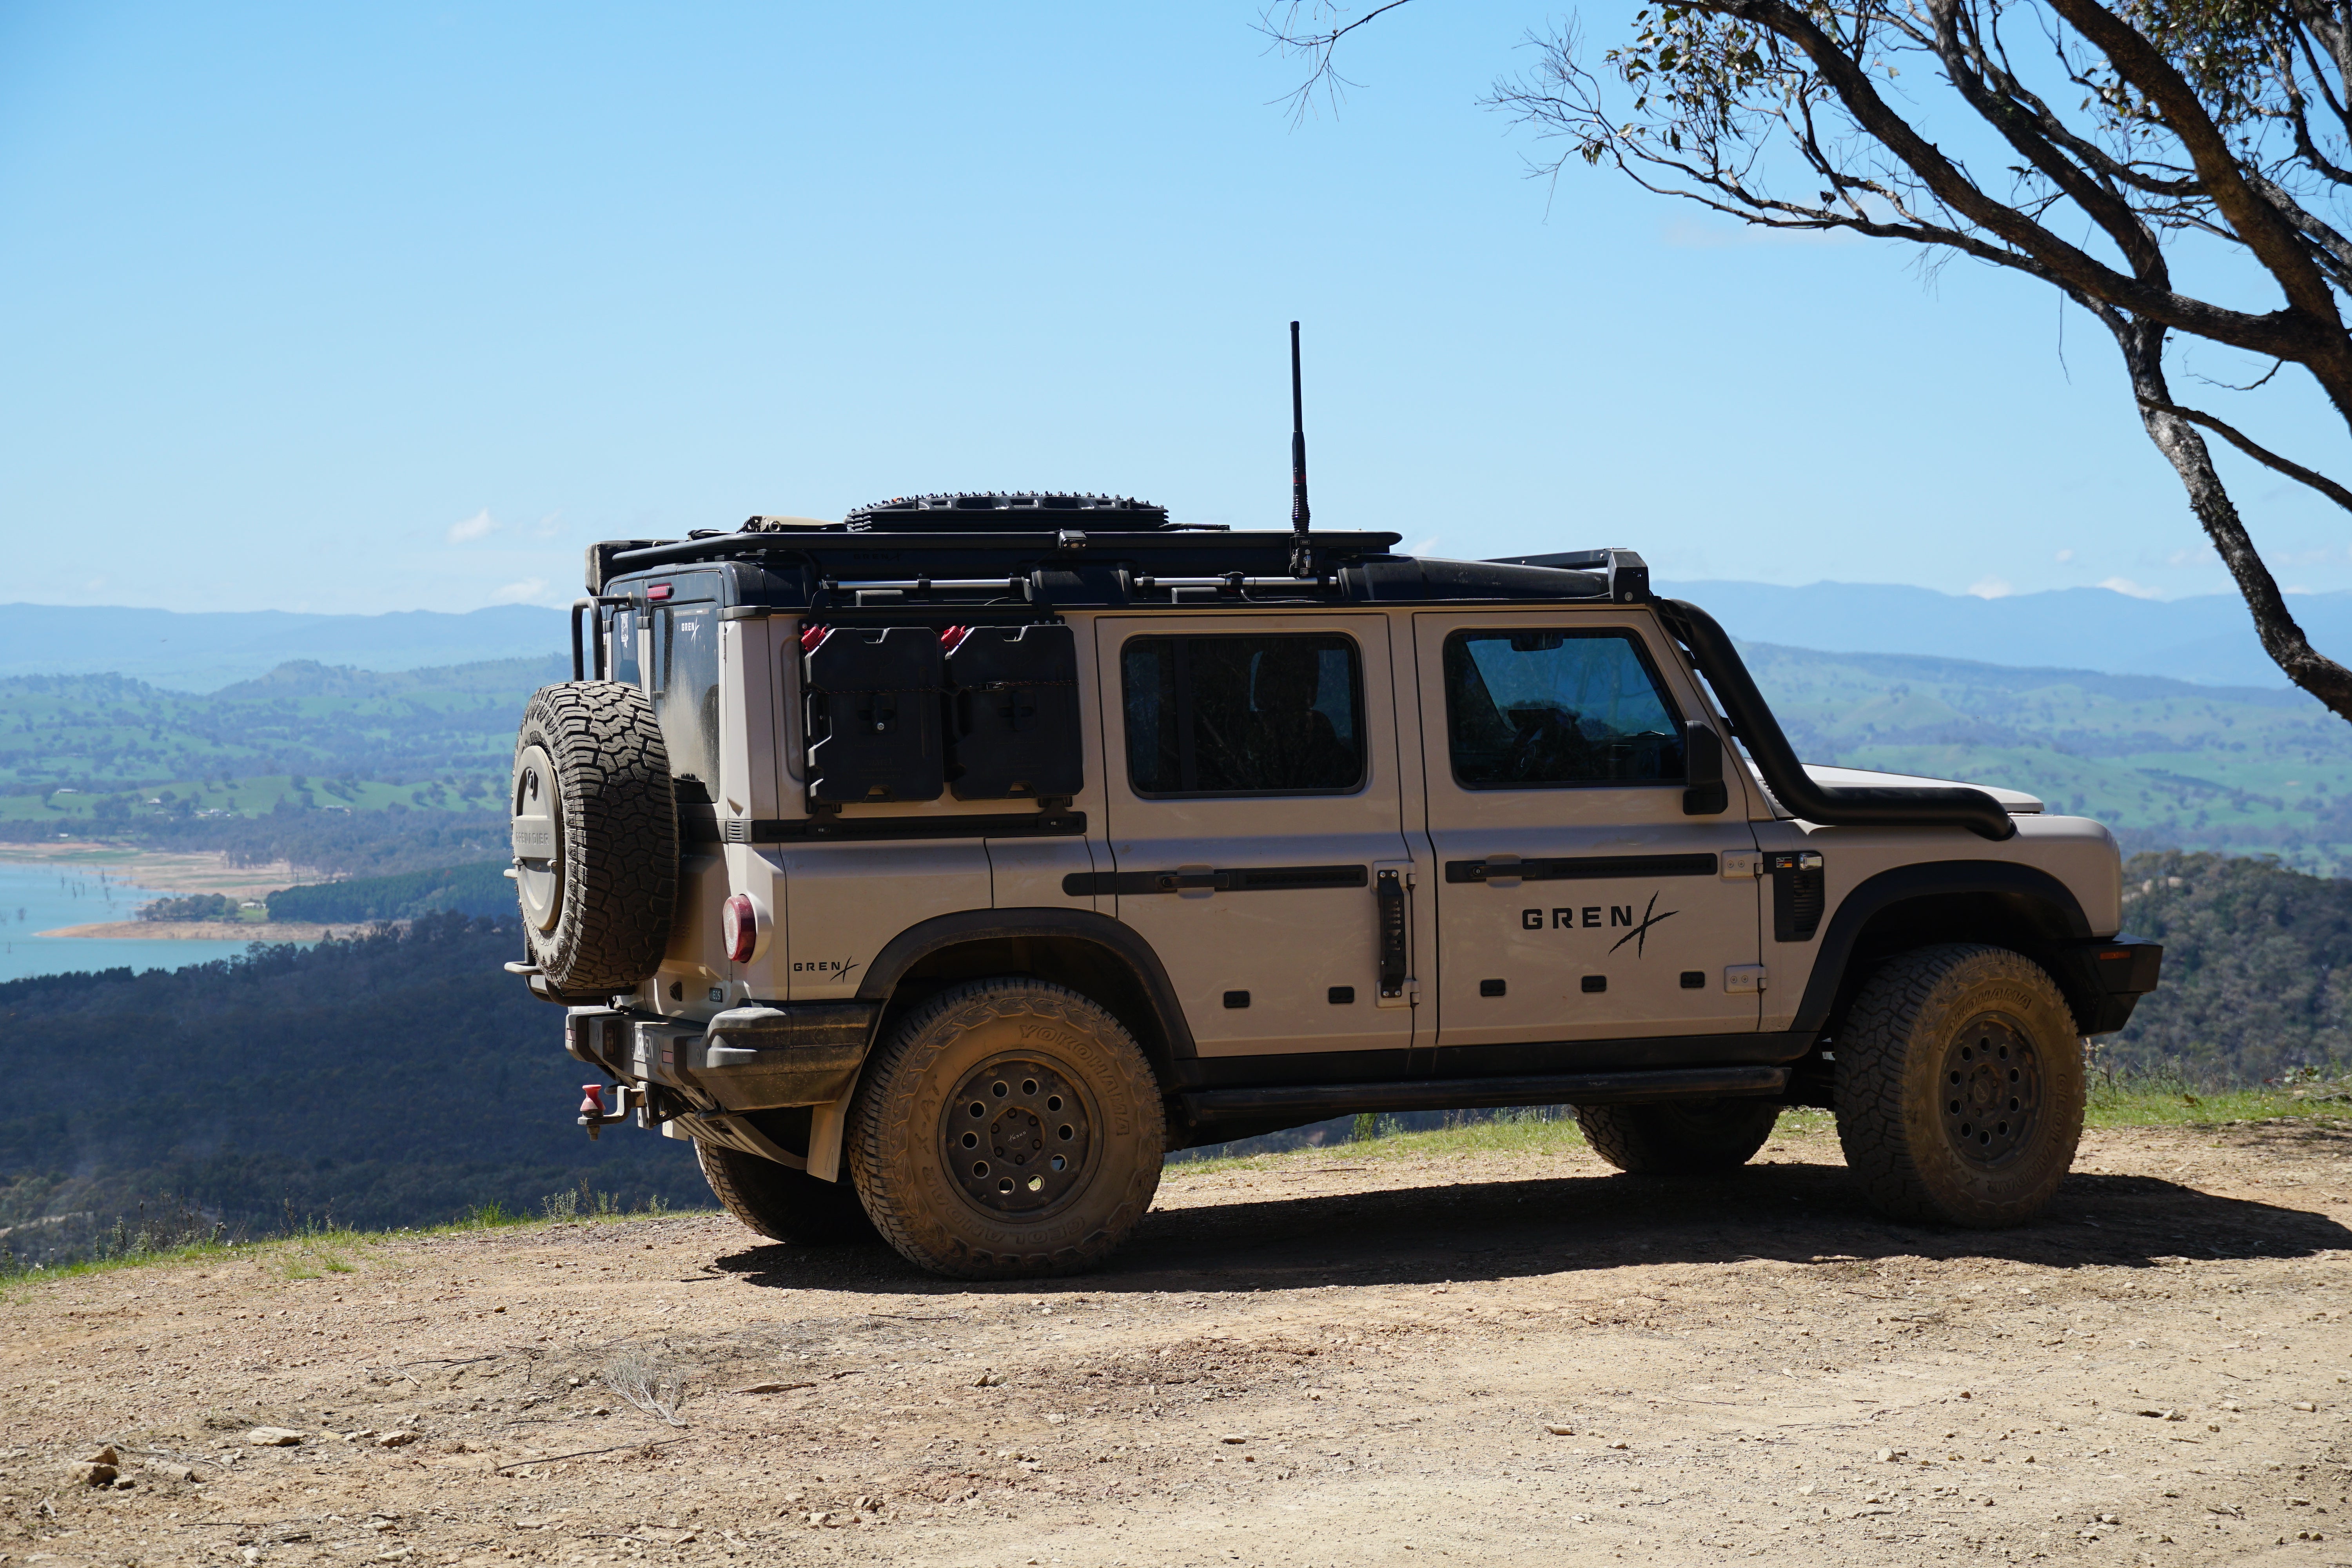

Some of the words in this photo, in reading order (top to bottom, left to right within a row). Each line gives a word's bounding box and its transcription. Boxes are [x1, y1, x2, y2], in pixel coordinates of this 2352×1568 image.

[516, 832, 549, 845] GRENADIER
[637, 1034, 653, 1059] GREN
[1939, 988, 2032, 1052] YOKOHAMA
[915, 1074, 939, 1155] X-AT
[1020, 1025, 1129, 1135] YOKOHAMA
[923, 1166, 1085, 1244] GEOLANDAR
